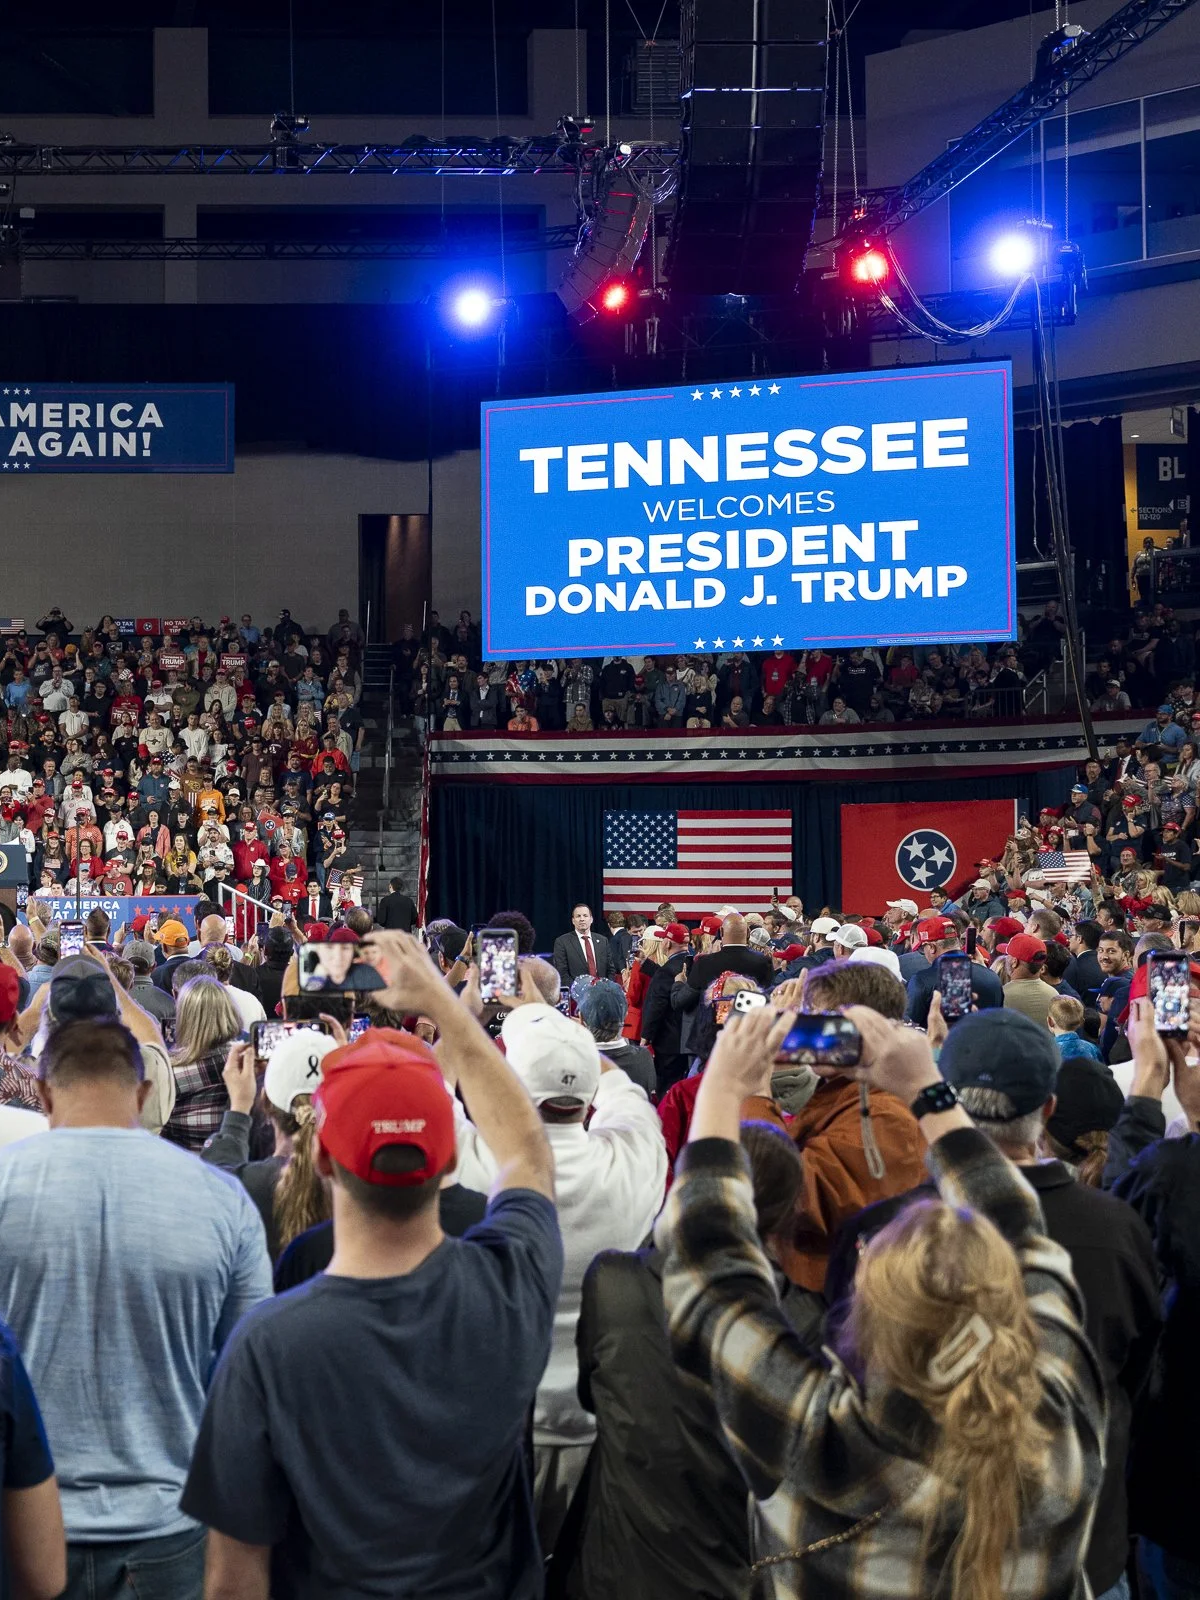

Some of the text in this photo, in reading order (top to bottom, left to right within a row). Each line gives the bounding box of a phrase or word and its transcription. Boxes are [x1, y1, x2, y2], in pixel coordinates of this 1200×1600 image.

[9, 432, 151, 456] AGAIN!
[520, 418, 968, 493] TENNESSEE
[643, 491, 834, 522] WELCOMES
[569, 520, 918, 577] PRESIDENT
[526, 566, 967, 615] DONALD J. TRUMP
[561, 1074, 576, 1086] 47
[371, 1119, 427, 1134] TRUMP
